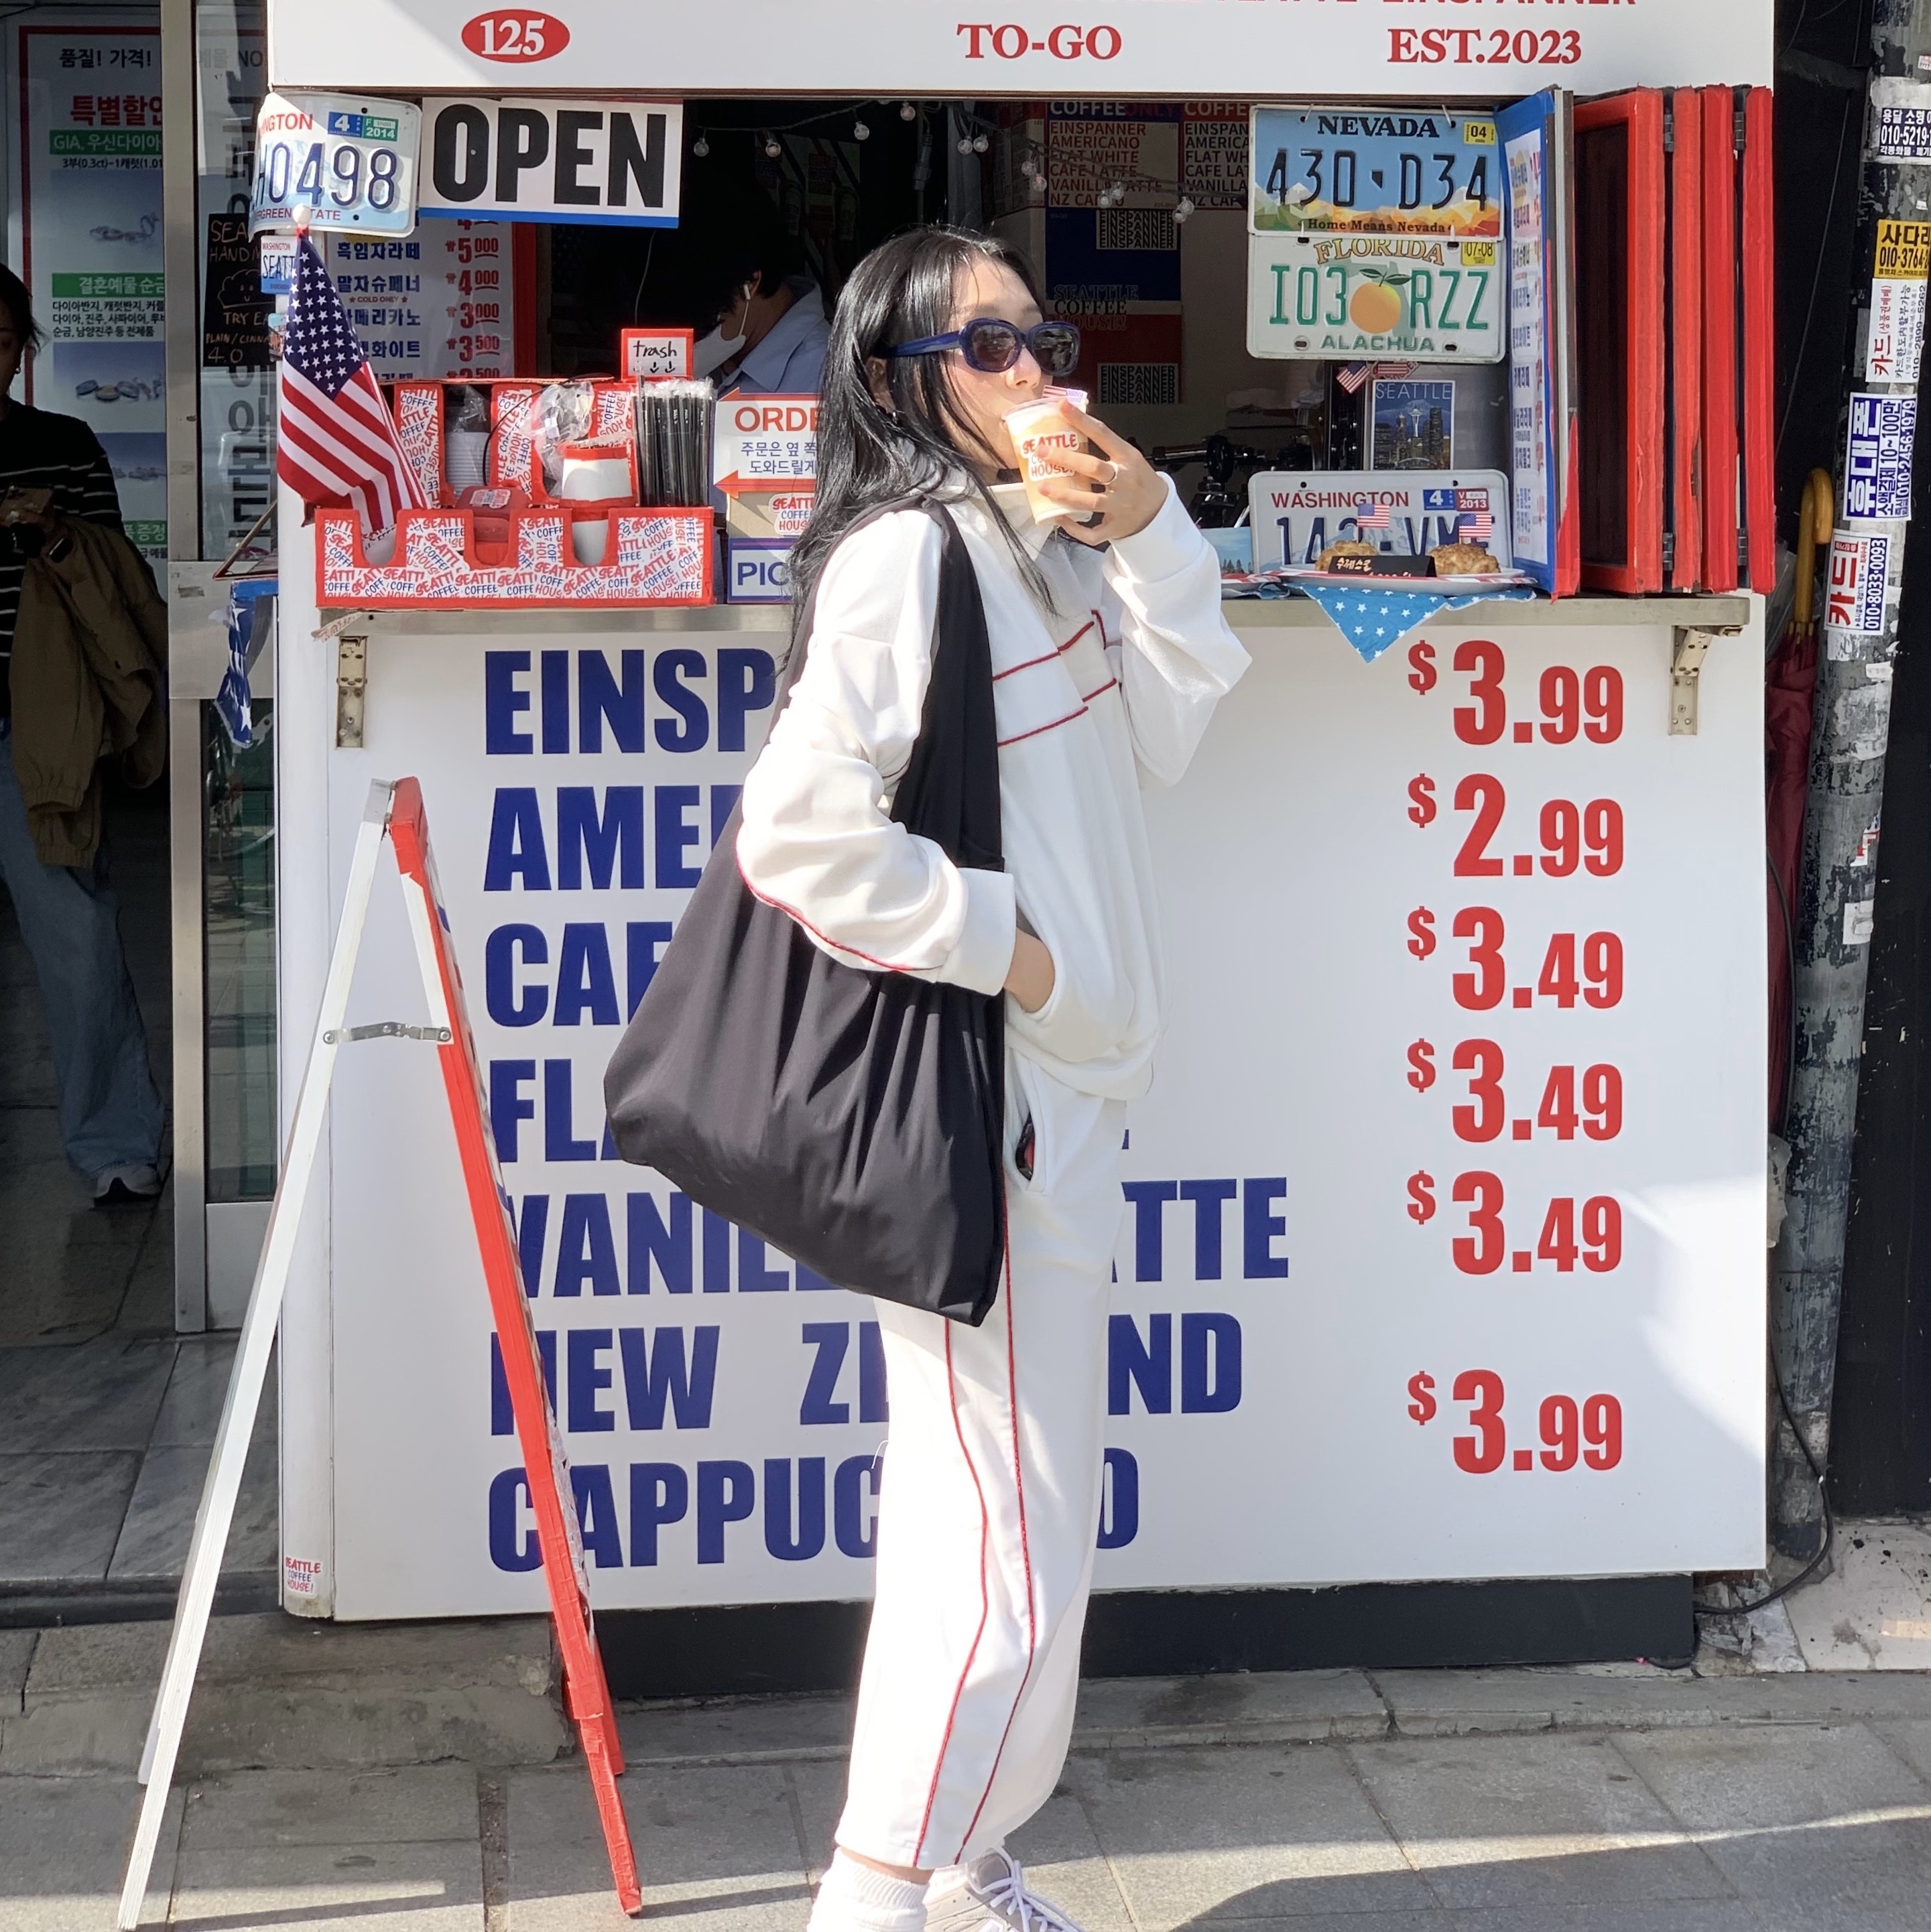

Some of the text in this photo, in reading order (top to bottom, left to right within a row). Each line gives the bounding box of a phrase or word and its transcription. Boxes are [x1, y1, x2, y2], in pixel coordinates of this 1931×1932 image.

[481, 18, 546, 56] 125
[956, 23, 1122, 60] TO-GO
[1387, 28, 1582, 64] EST.2023
[60, 48, 151, 68] 품질! 가격!
[1050, 101, 1125, 116] COFFEE
[334, 115, 350, 132] 4
[1050, 122, 1146, 135] EINSPANNER
[1317, 115, 1440, 138] NEVADA
[1470, 125, 1487, 138] 04
[366, 127, 395, 139] 2014
[1050, 135, 1139, 149] AMERICANO
[433, 103, 667, 208] OPEN
[1091, 150, 1139, 163] WHITE
[1186, 151, 1221, 163] FLAT
[1186, 165, 1221, 177] CAFE
[1050, 194, 1070, 206] NZ
[310, 208, 341, 221] TATE
[1308, 219, 1446, 233] Home Means Nevada
[336, 241, 421, 261] 흑임자라떼
[1099, 239, 1174, 248] EINSPANNER
[1313, 239, 1445, 266] FLORIDA
[1053, 300, 1127, 316] COFFEE
[1410, 269, 1489, 330] RZZ
[223, 312, 249, 326] TRY
[347, 309, 421, 326] 메리카노
[1320, 335, 1434, 352] ALACHUA
[1870, 335, 1893, 377] 카드
[1101, 365, 1175, 375] EINSPANNER
[1376, 383, 1452, 399] SEATTLE
[741, 441, 782, 457] 주문은
[786, 442, 800, 457] 옆
[1848, 400, 1881, 515] 휴대폰
[1271, 491, 1409, 509] WASHINGTON
[1429, 490, 1444, 506] 4
[1877, 467, 1896, 516] 소액결제
[1460, 499, 1487, 509] 2013
[1828, 555, 1857, 626] 카드
[485, 648, 776, 755] EINSP
[1408, 640, 1624, 745] $3.99
[1408, 773, 1624, 877] $2.99
[1407, 906, 1624, 1011] $3.49
[1407, 1038, 1623, 1143] $3.49
[490, 1059, 618, 1163] FL
[1407, 1170, 1623, 1275] $3.49
[513, 1177, 1288, 1298] VANIL TTE
[1407, 1369, 1623, 1474] $3.99
